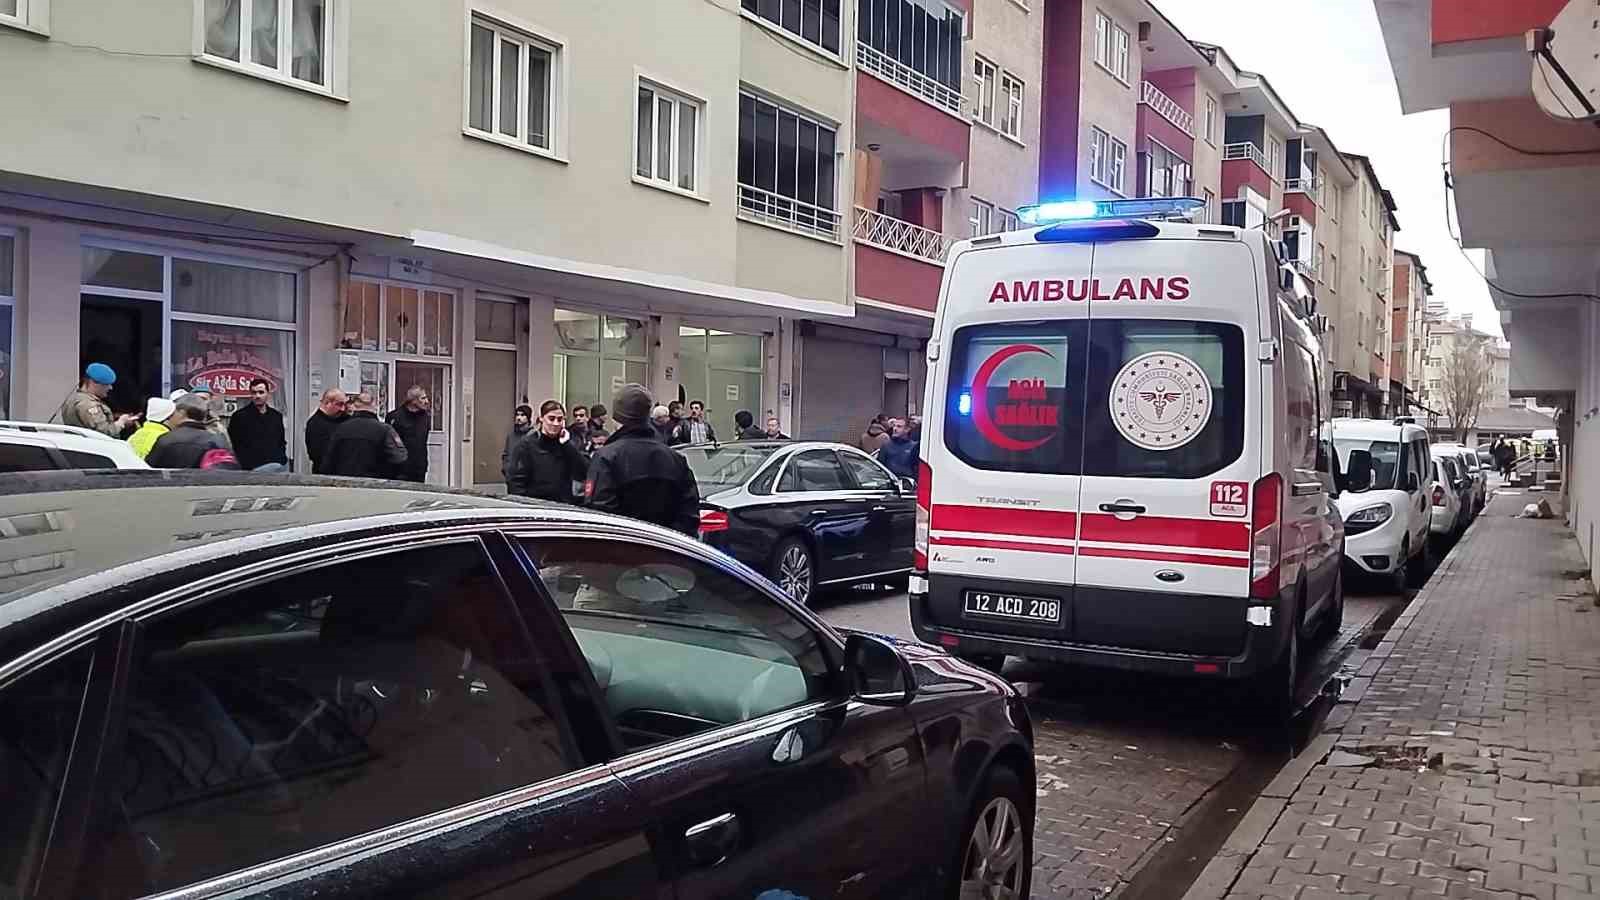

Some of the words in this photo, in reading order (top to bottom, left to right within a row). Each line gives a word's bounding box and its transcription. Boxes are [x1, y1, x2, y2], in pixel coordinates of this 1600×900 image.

[988, 277, 1190, 303] AMBULANS
[1215, 485, 1243, 503] 112
[975, 594, 990, 611] 12
[996, 597, 1023, 615] ACD
[1029, 600, 1057, 618] 208
